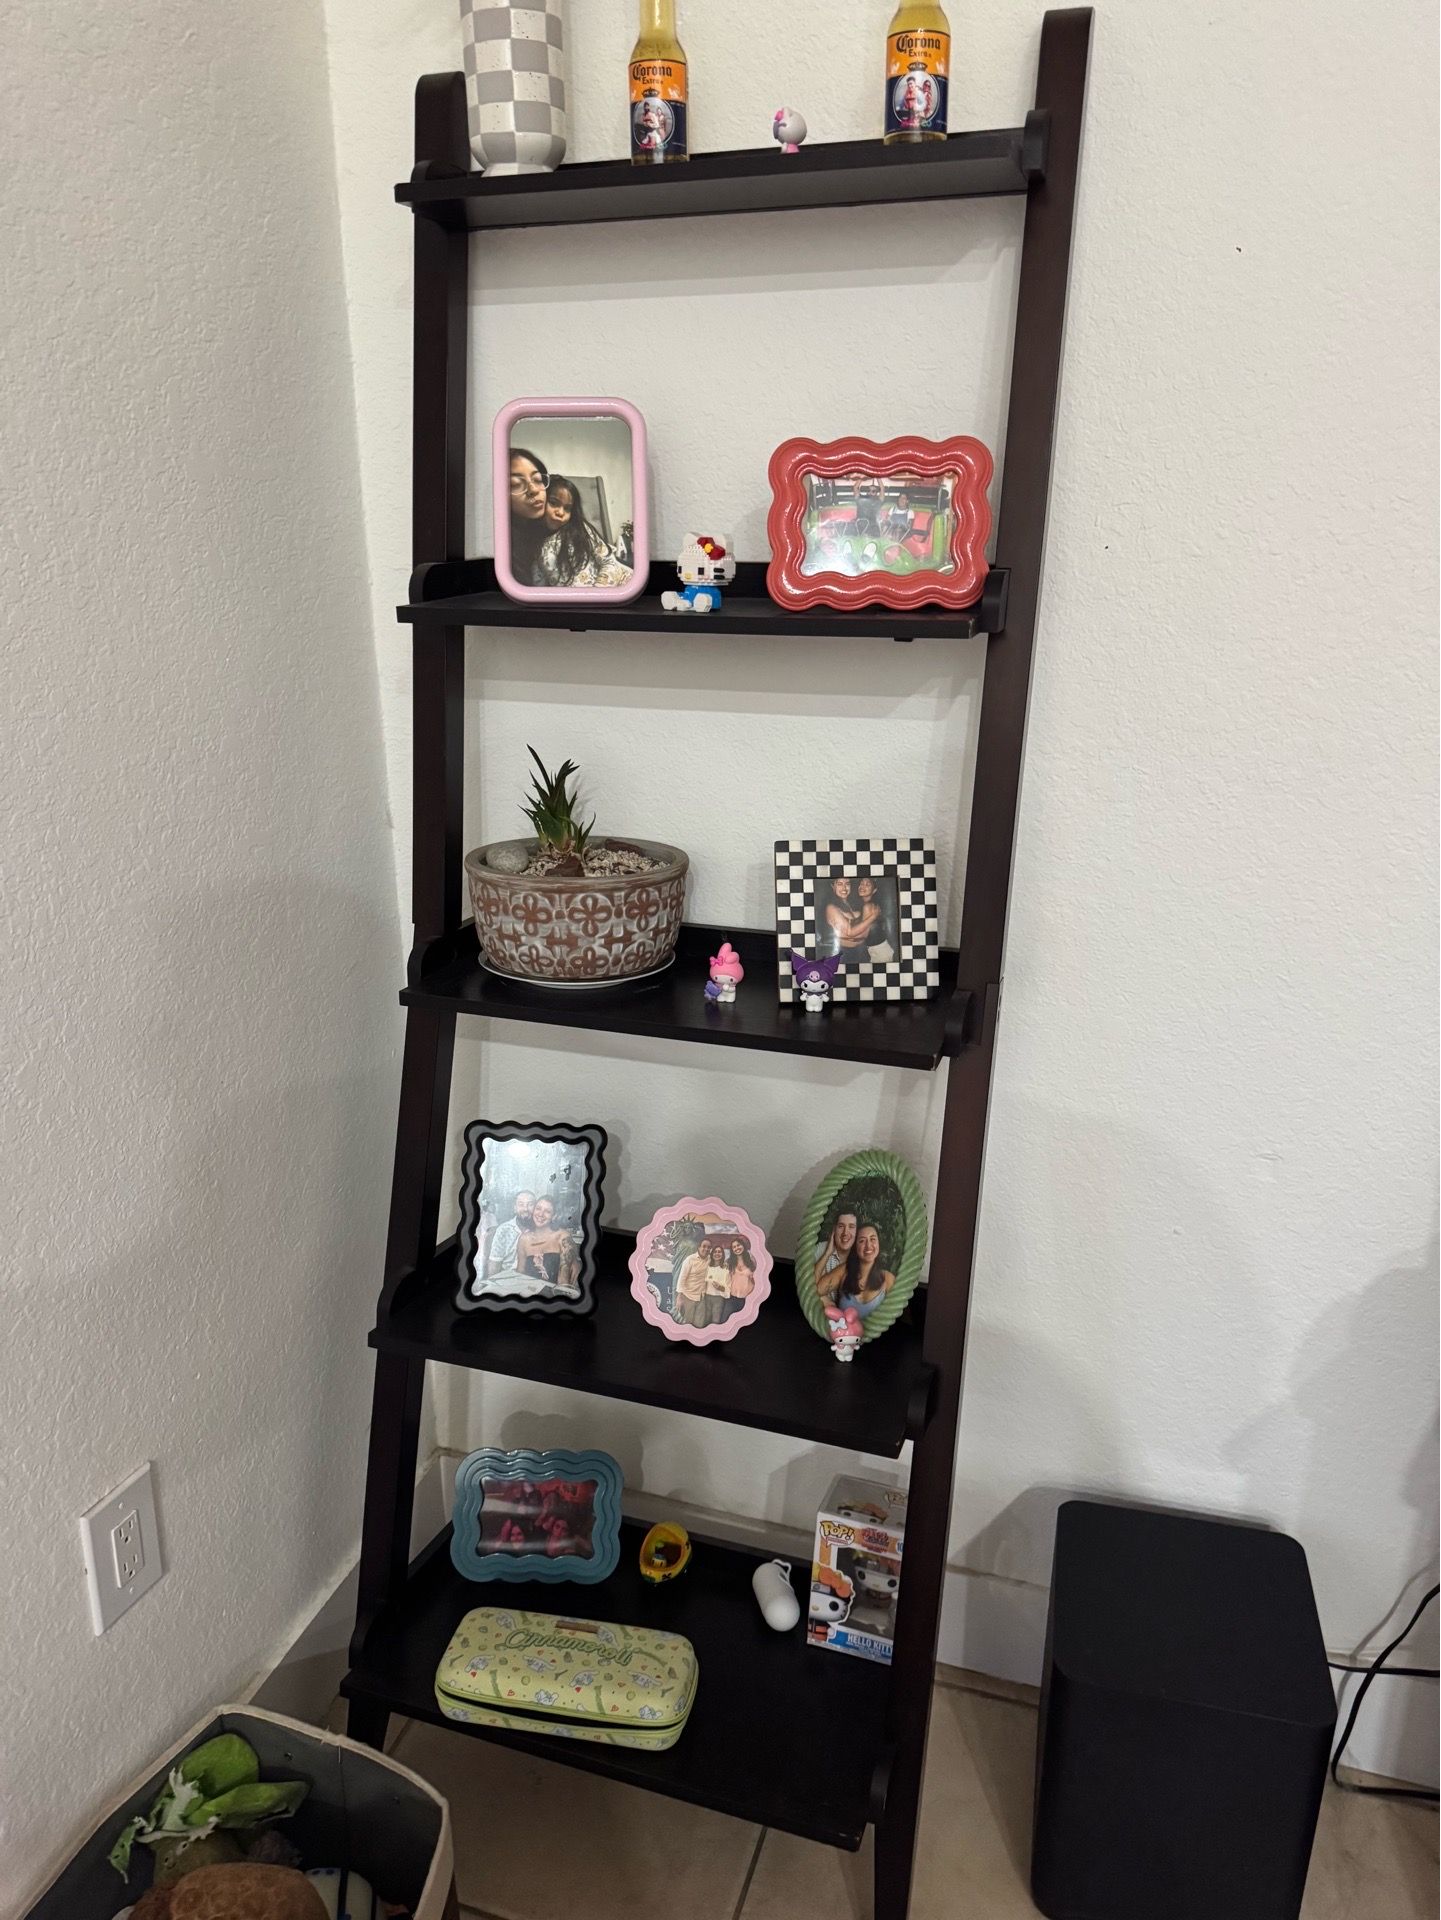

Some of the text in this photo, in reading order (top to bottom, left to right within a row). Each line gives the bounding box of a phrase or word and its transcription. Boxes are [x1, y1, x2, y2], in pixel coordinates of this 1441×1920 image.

[896, 35, 941, 53] Corona
[908, 49, 928, 57] Extra
[632, 63, 672, 80] Corona
[847, 1633, 872, 1649] HELLO
[873, 1641, 893, 1656] KITTY
